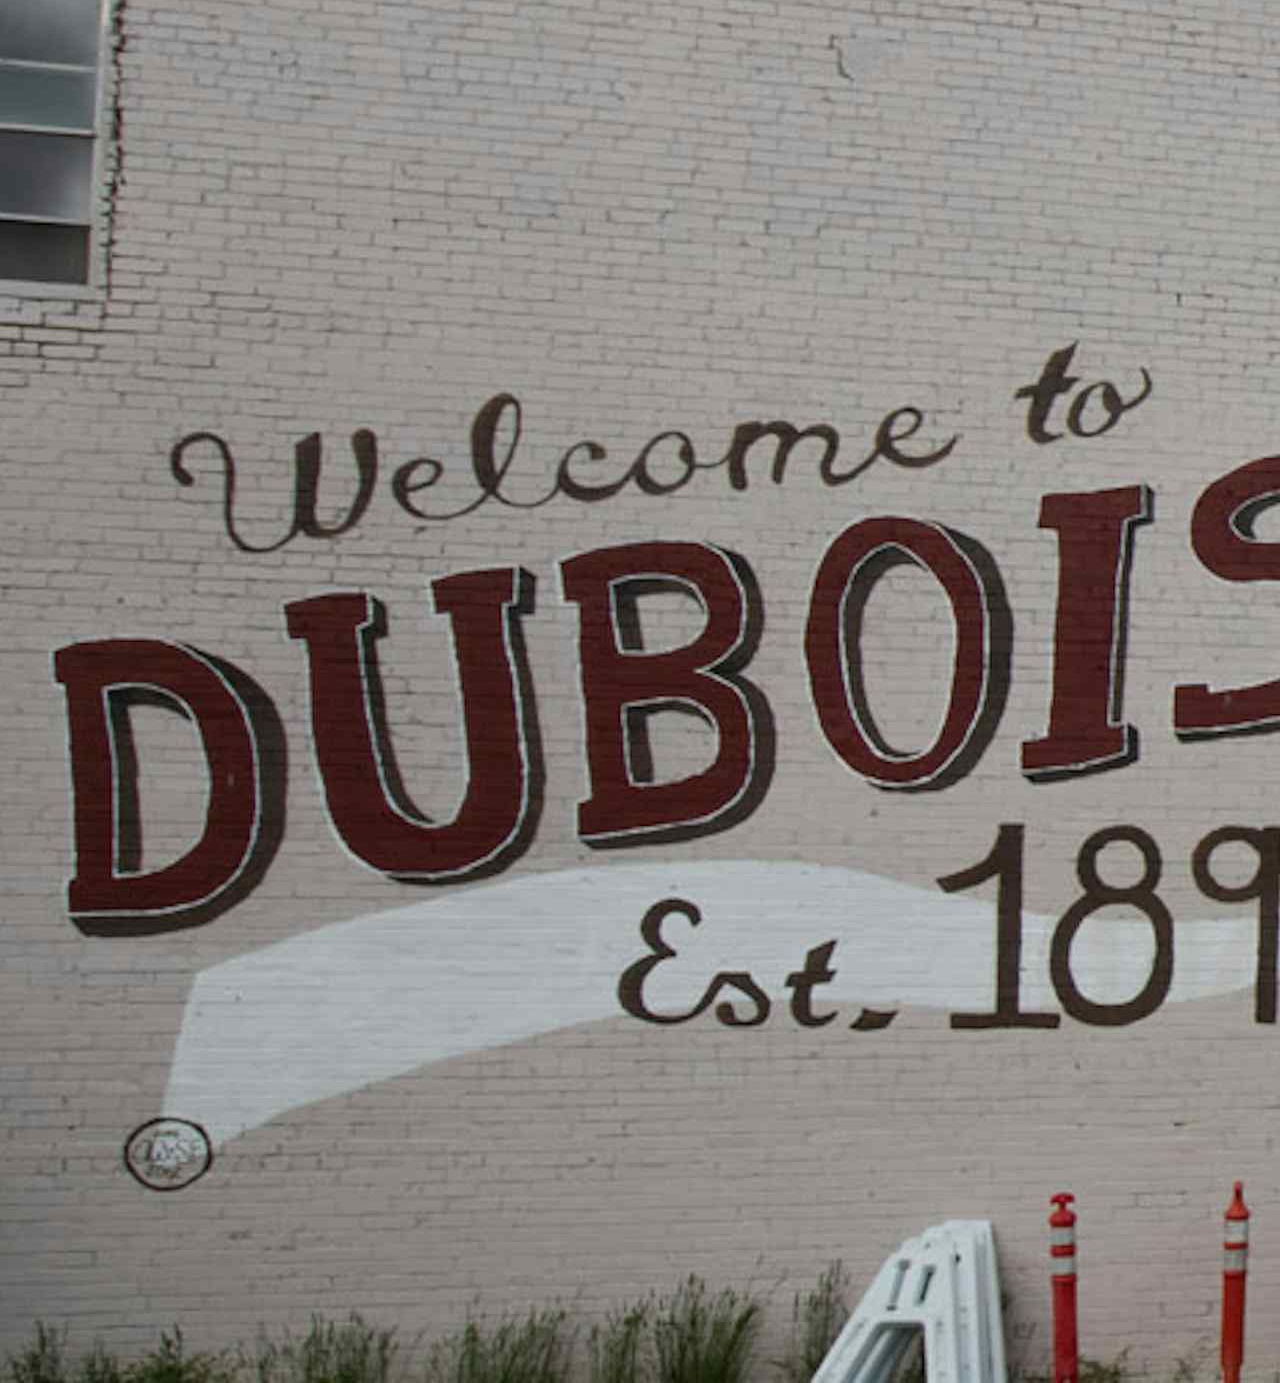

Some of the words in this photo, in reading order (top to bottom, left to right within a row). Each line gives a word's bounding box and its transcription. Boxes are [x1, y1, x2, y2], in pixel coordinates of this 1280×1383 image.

[170, 392, 960, 553] Welcome
[1013, 339, 1152, 445] to
[618, 897, 900, 1031] Est.
